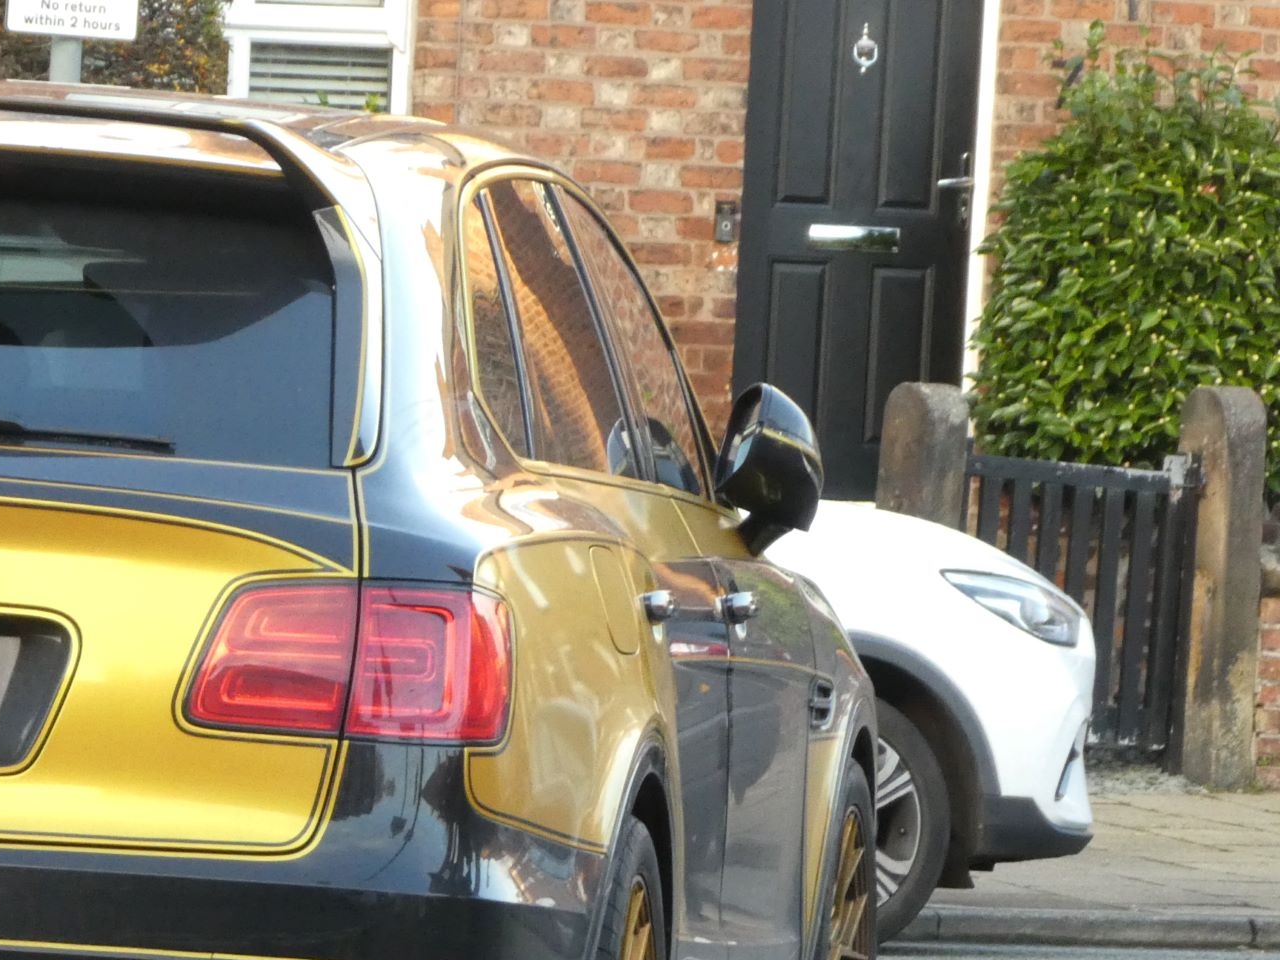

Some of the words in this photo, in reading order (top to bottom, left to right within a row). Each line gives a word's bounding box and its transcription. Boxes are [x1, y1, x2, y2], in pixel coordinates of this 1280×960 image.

[40, 0, 59, 11] No
[64, 1, 106, 14] return
[24, 14, 65, 27] within
[70, 16, 78, 28] 2
[83, 18, 120, 31] hours
